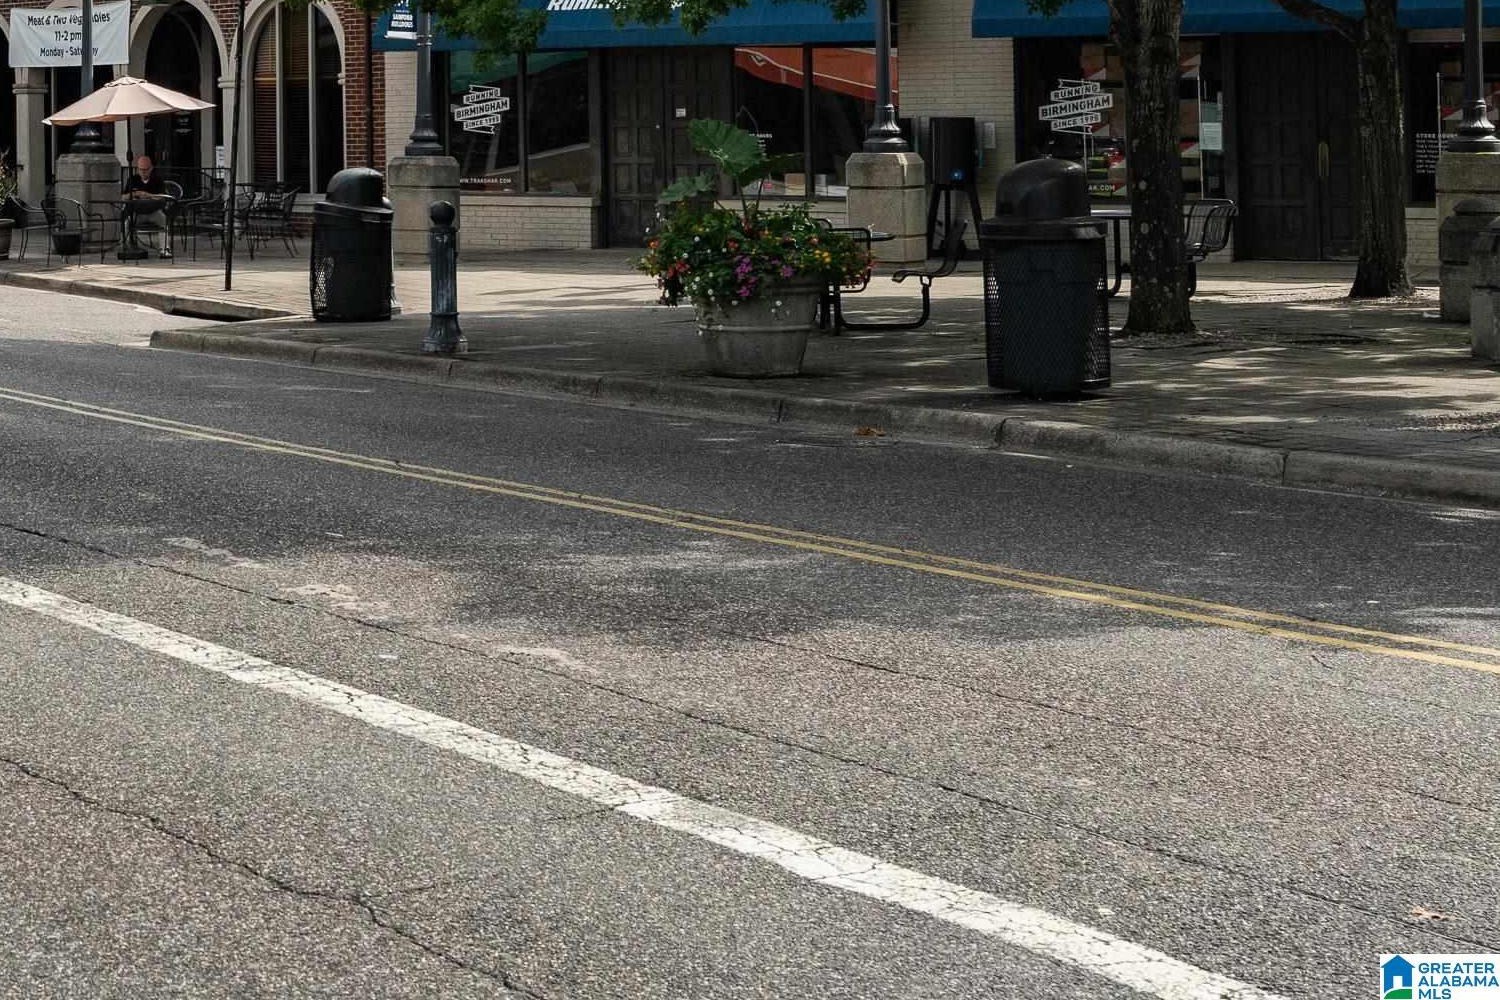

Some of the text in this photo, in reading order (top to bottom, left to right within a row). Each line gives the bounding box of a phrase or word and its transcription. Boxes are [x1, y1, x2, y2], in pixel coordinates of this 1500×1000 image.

[27, 14, 44, 26] Meat
[53, 14, 67, 25] Two
[54, 30, 82, 43] 11-2 pm
[40, 47, 64, 58] Monday
[466, 89, 499, 102] RUNNING
[1053, 84, 1099, 99] RUNNING
[457, 99, 507, 118] BIRMINGHAM
[1042, 95, 1110, 117] BIRMINGHAM
[1053, 119, 1077, 129] SINCE
